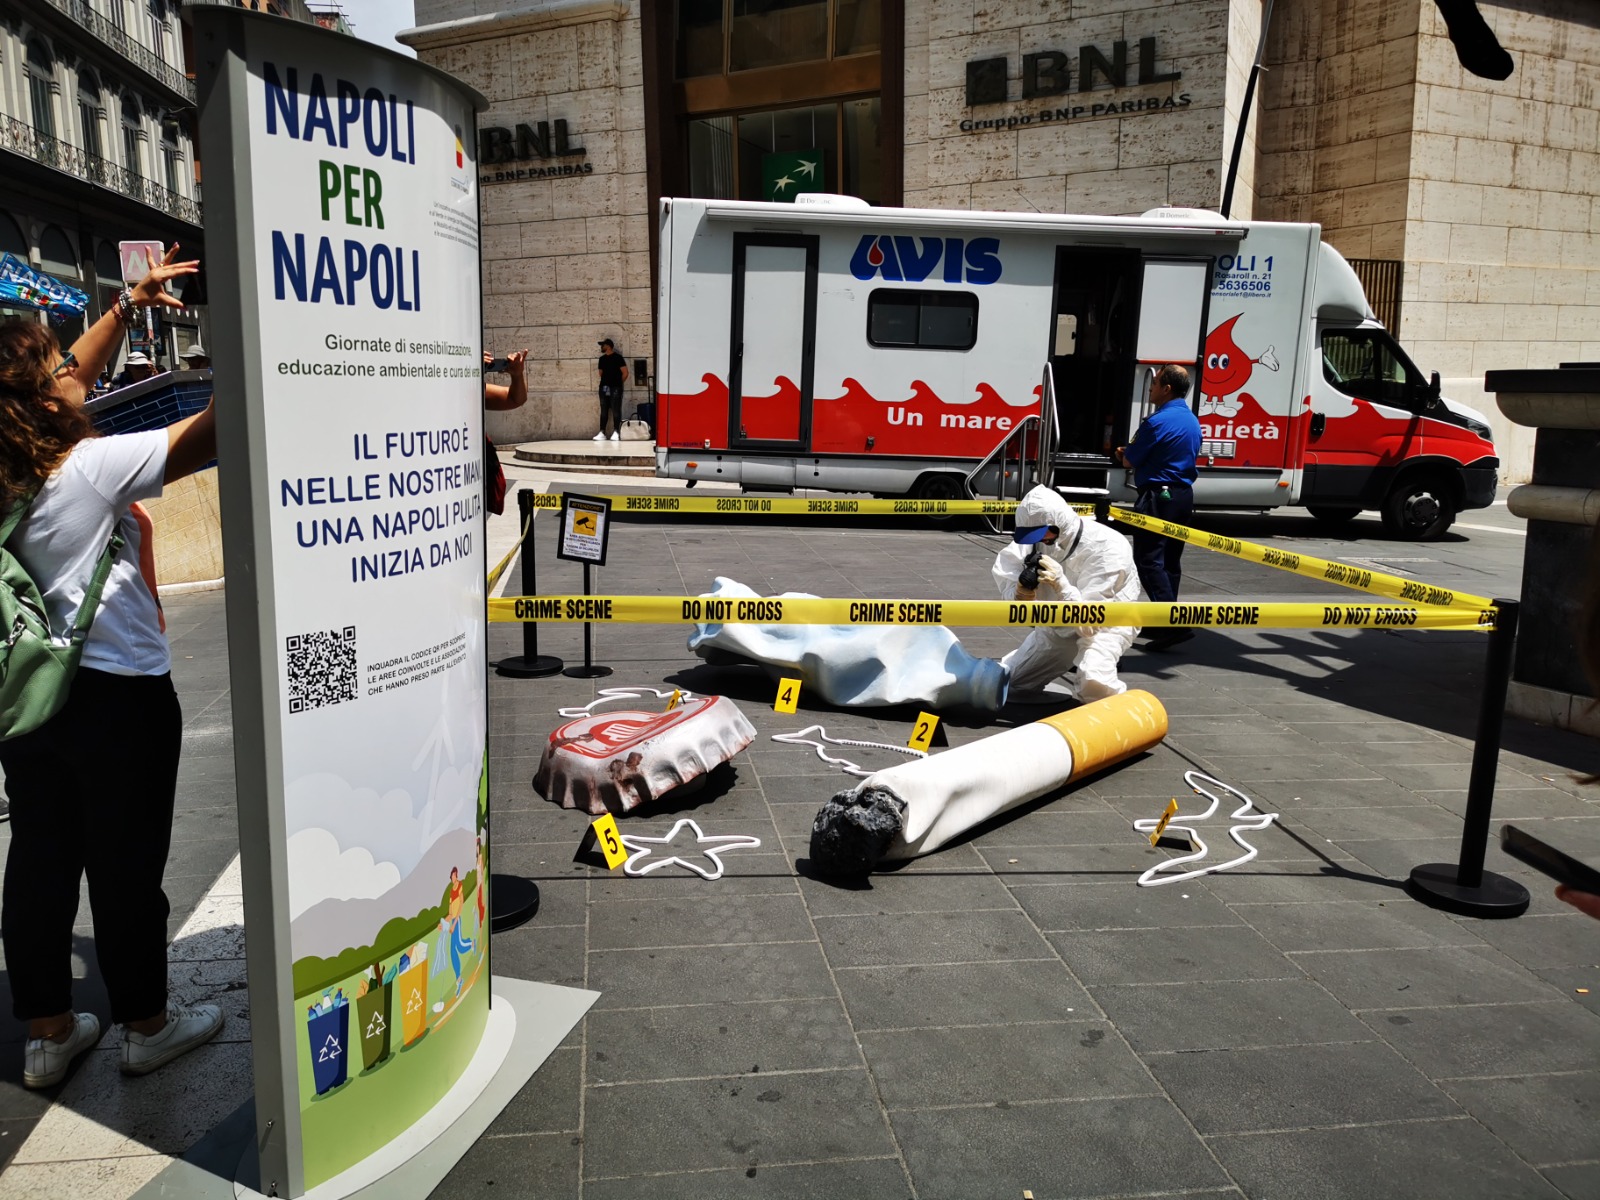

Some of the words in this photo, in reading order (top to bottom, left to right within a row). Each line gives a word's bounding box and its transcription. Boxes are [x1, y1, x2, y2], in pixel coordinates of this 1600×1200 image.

[1022, 36, 1182, 100] BNL
[263, 61, 415, 165] NAPOLI
[959, 115, 1031, 132] Gruppo
[1040, 106, 1085, 122] BNP
[1091, 93, 1192, 116] PARIBAS
[478, 118, 587, 165] BNL
[495, 169, 525, 183] BNP
[528, 162, 593, 178] PARIBAS
[319, 159, 385, 230] PER
[271, 230, 421, 312] NAPOLI
[850, 234, 1003, 285] AVIS
[1264, 255, 1273, 272] 1
[1218, 280, 1271, 291] 5636506
[325, 334, 392, 353] Giornate
[395, 336, 406, 354] di
[278, 359, 375, 377] educazione
[379, 362, 441, 378] ambientale
[443, 368, 448, 378] e
[449, 367, 464, 378] cura
[887, 406, 923, 426] Un
[940, 413, 1012, 431] mare
[354, 433, 378, 460] IL
[386, 428, 460, 459] FUTURO
[463, 422, 469, 450] È
[281, 473, 381, 507] NELLE
[389, 464, 461, 499] NOSTRE
[297, 516, 364, 548] UNA
[372, 503, 449, 540] NAPOLI
[453, 493, 481, 525] PULITA
[351, 547, 425, 583] INIZIA
[430, 540, 451, 568] DA
[454, 532, 472, 561] NOI
[514, 599, 561, 619] CRIME
[566, 599, 612, 619] SCENE
[682, 600, 701, 620] DO
[705, 600, 733, 620] NOT
[737, 600, 782, 621] CROSS
[850, 602, 894, 622] CRIME
[898, 603, 942, 623] SCENE
[1008, 604, 1027, 624] DO
[1031, 604, 1058, 624] NOT
[1062, 604, 1105, 624] CROSS
[1169, 605, 1213, 625] CRIME
[1216, 606, 1259, 625] SCENE
[1322, 607, 1341, 625] DO
[1344, 607, 1371, 625] NOT
[1374, 607, 1418, 625] CROSS
[367, 657, 403, 672] INQUADRA
[404, 655, 410, 663] IL
[411, 647, 432, 661] CODICE
[432, 645, 440, 654] QR
[440, 642, 449, 651] PER
[367, 675, 377, 684] LE
[378, 669, 397, 682] AREE
[398, 658, 430, 676] COINVOLTE
[430, 657, 434, 665] E
[435, 655, 441, 664] LE
[367, 685, 383, 696] CHE
[386, 678, 409, 691] HANNO
[411, 671, 429, 684] PRESO
[431, 664, 445, 676] PARTE
[781, 686, 793, 705] 4
[916, 721, 928, 743] 2
[1157, 813, 1169, 834] 6
[605, 827, 619, 856] 5
